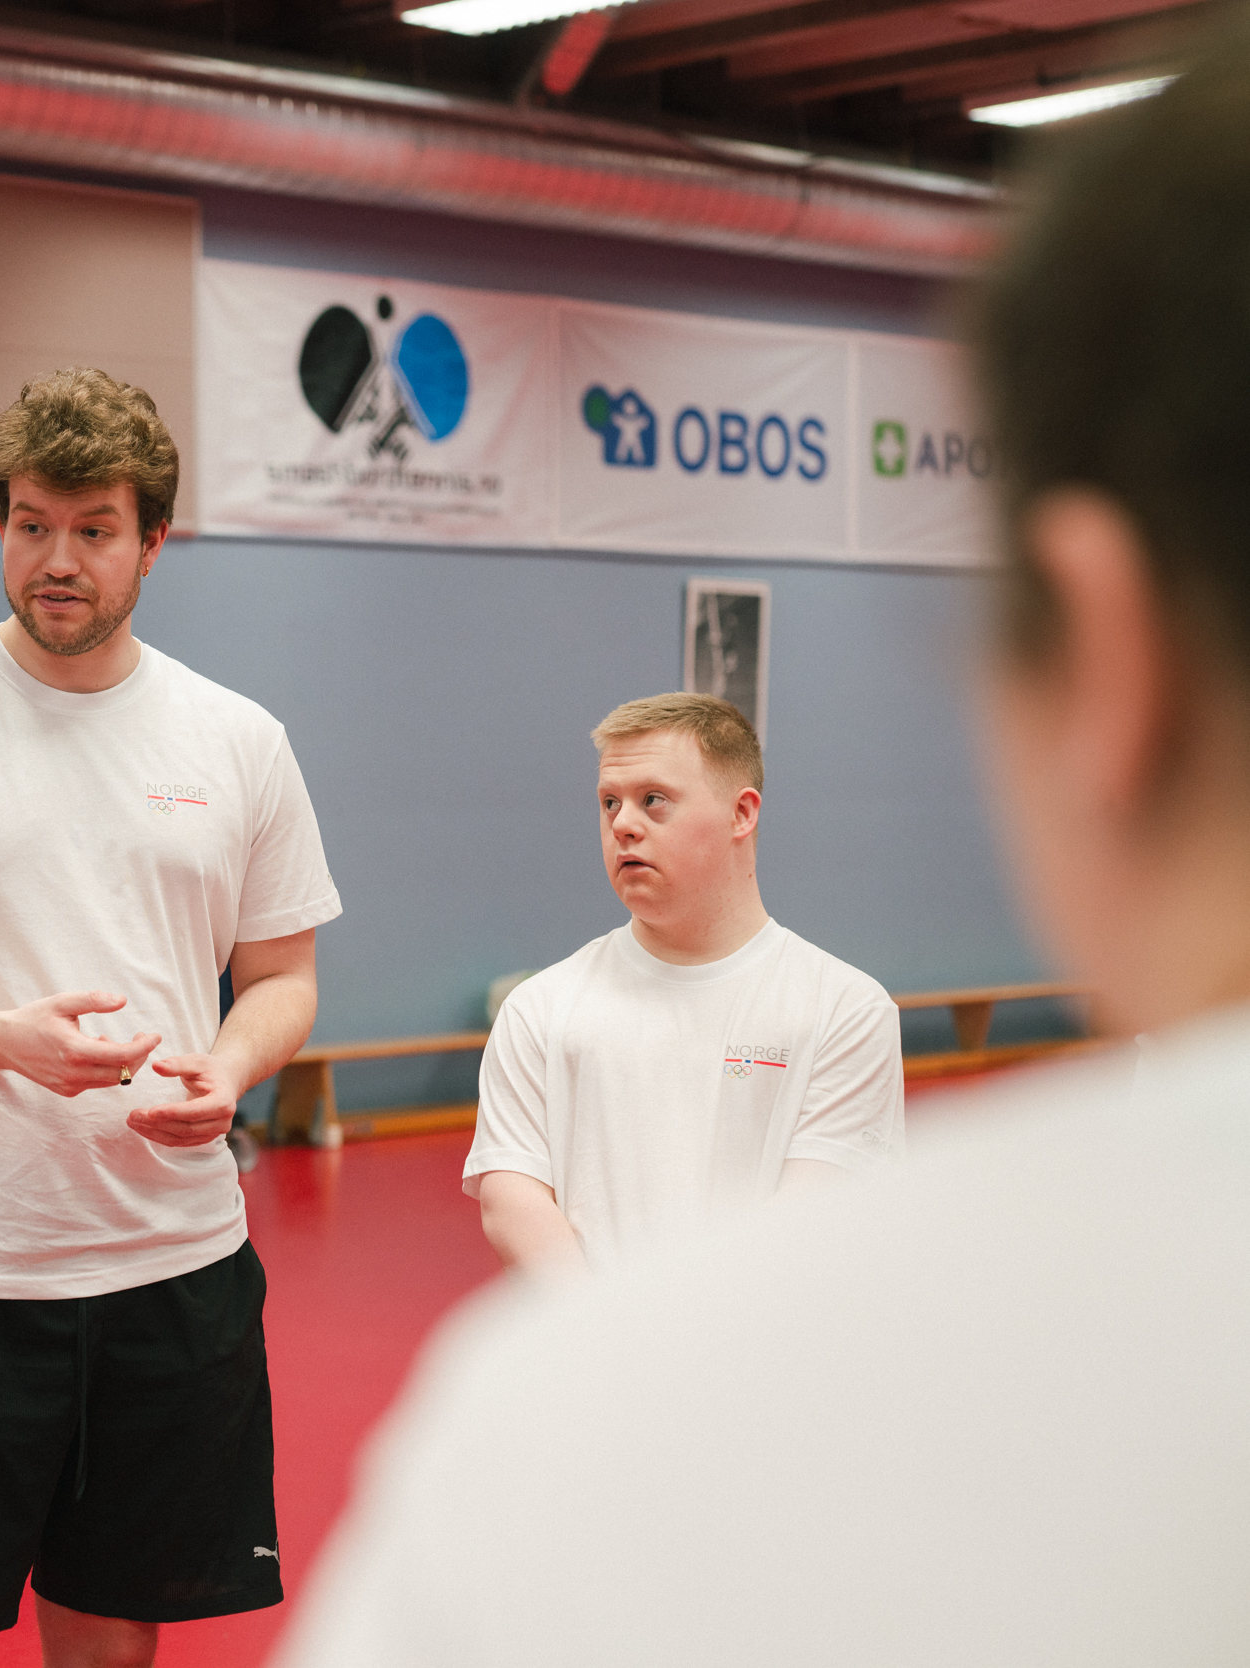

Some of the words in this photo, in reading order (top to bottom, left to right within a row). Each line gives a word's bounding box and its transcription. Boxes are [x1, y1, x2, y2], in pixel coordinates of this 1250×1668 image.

[674, 407, 827, 480] OBOS
[146, 782, 208, 801] NORGE
[726, 1044, 790, 1063] NORGE
